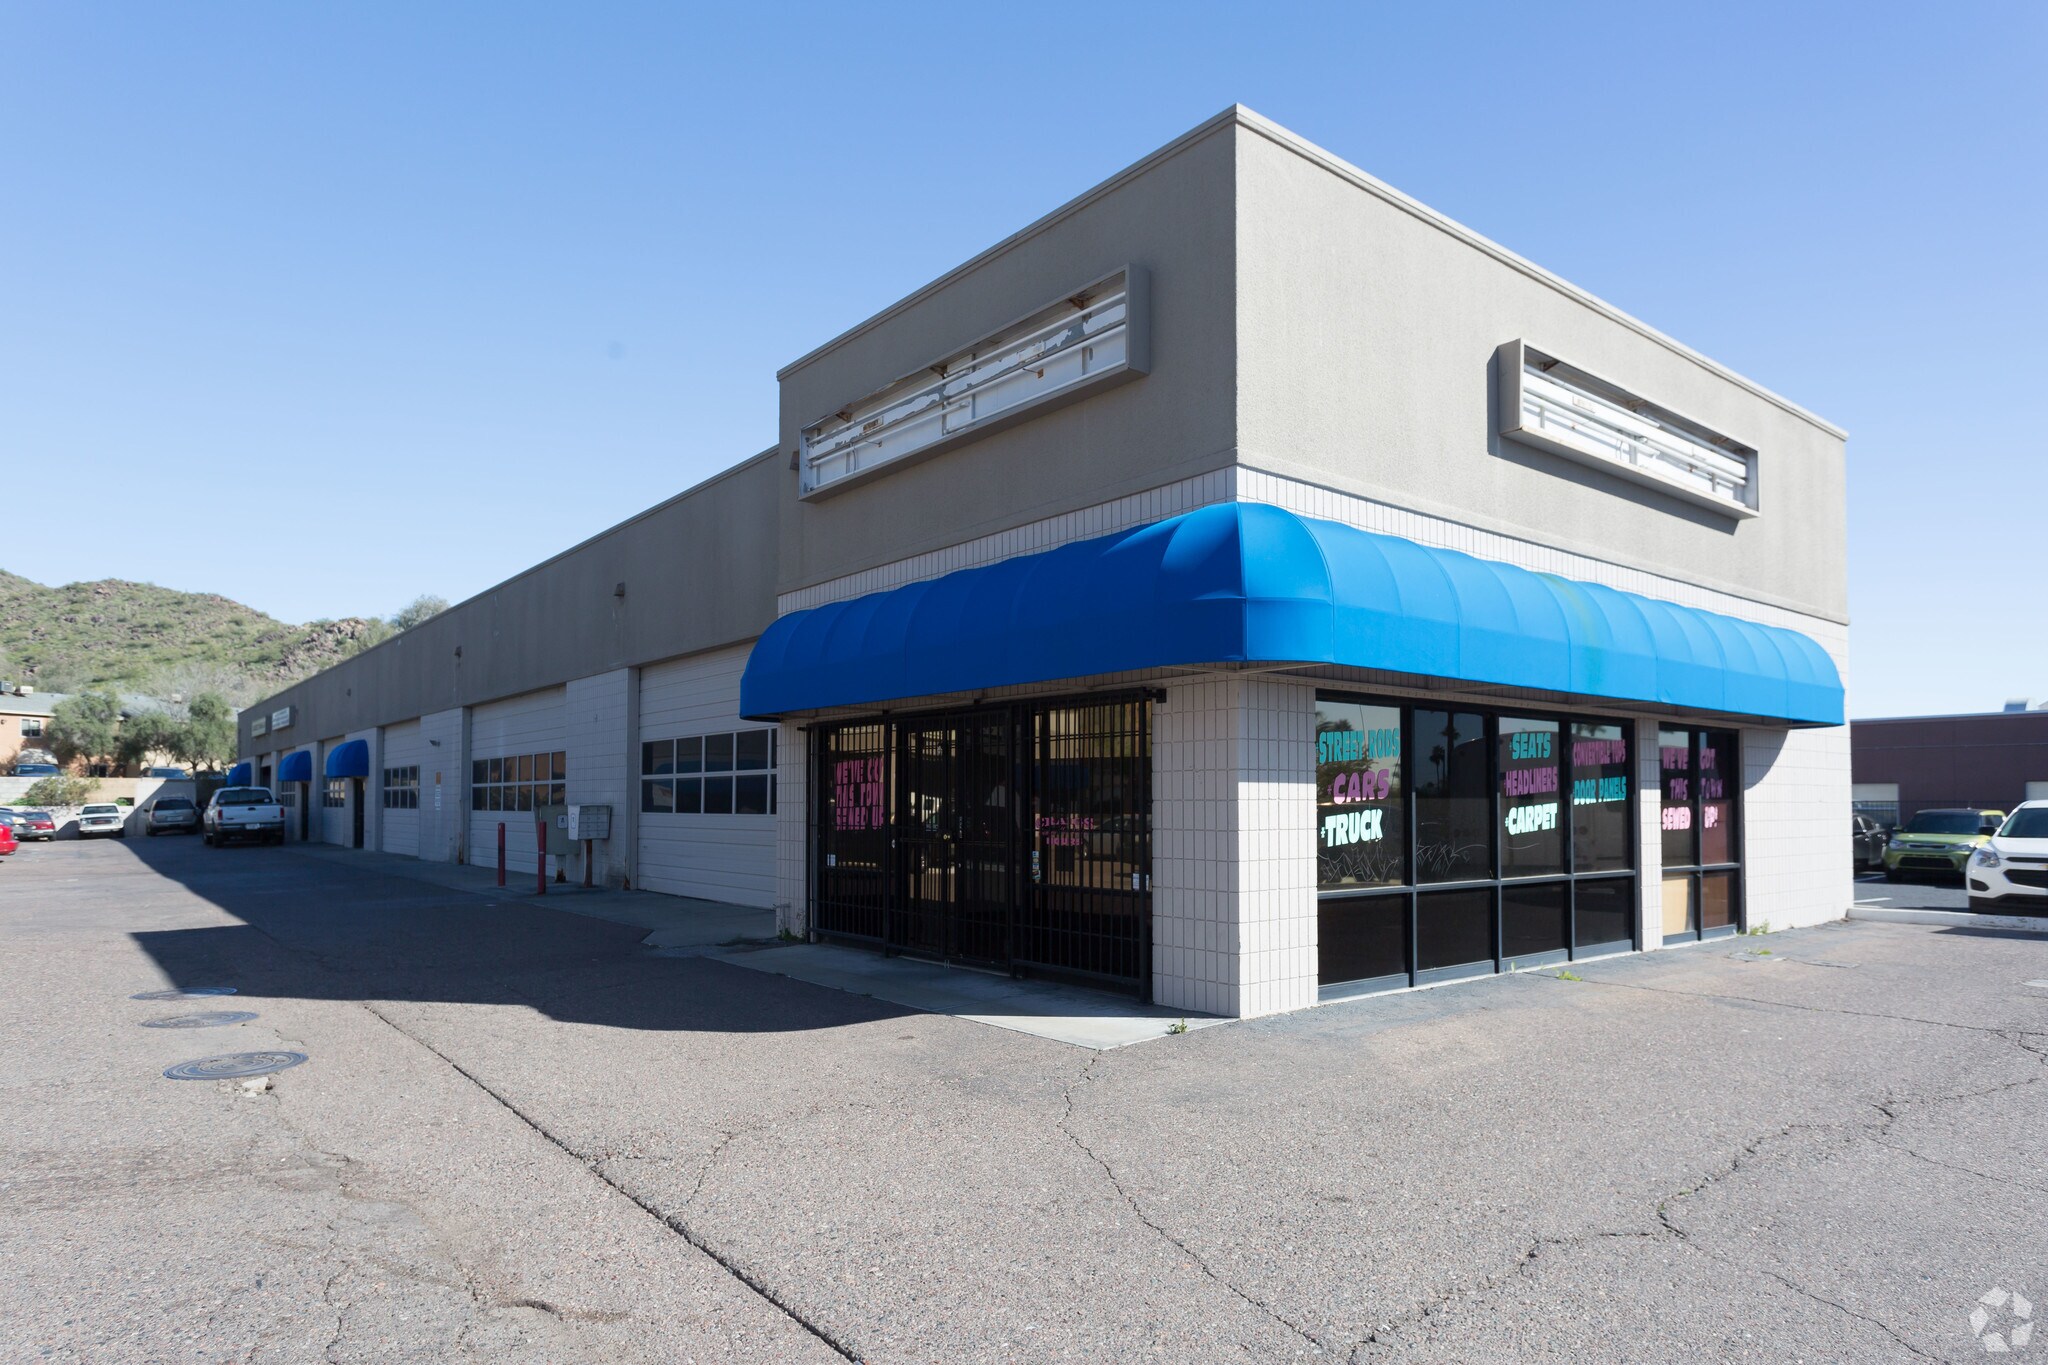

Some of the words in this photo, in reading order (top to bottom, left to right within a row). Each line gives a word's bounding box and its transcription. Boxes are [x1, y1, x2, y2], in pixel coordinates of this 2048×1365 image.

[1318, 730, 1364, 764] STREET
[1367, 728, 1400, 759] RODS
[1511, 732, 1551, 760] SEATS
[1333, 768, 1390, 805] CARS
[1505, 766, 1558, 797] HEADLINERS
[1573, 779, 1597, 806] DOOR
[1597, 776, 1627, 803] PANELS
[1325, 809, 1383, 848] TRUCK
[1507, 802, 1558, 836] CARPET
[1662, 806, 1691, 830] SEWED
